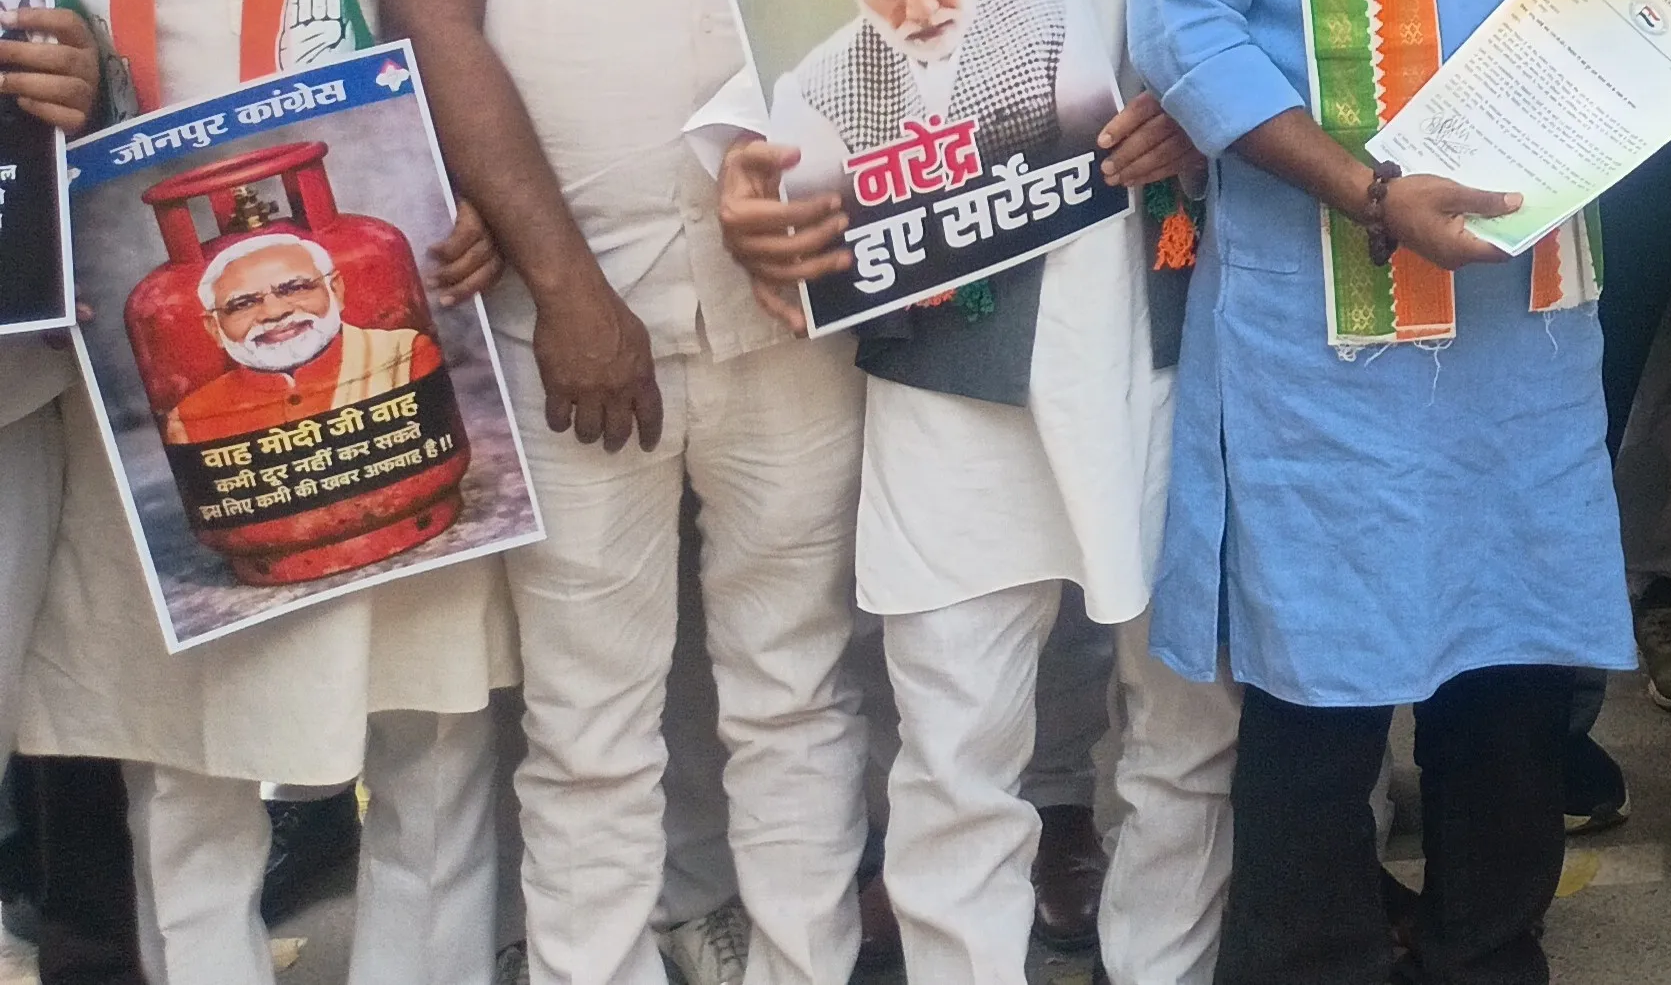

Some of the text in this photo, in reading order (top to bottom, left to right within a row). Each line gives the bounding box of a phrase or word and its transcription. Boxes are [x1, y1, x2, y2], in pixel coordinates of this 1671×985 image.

[110, 80, 347, 165] जौनपुर कांग्रेस
[844, 114, 982, 207] नरेंद्र
[844, 207, 926, 293] हुए
[201, 392, 419, 468] वाह मोदी जी वाह
[214, 421, 421, 494] कमी दूर नहीं कर सकते
[255, 488, 292, 509] कमी
[294, 478, 318, 497] की
[320, 469, 361, 491] खबर
[363, 448, 422, 479] अफवाह
